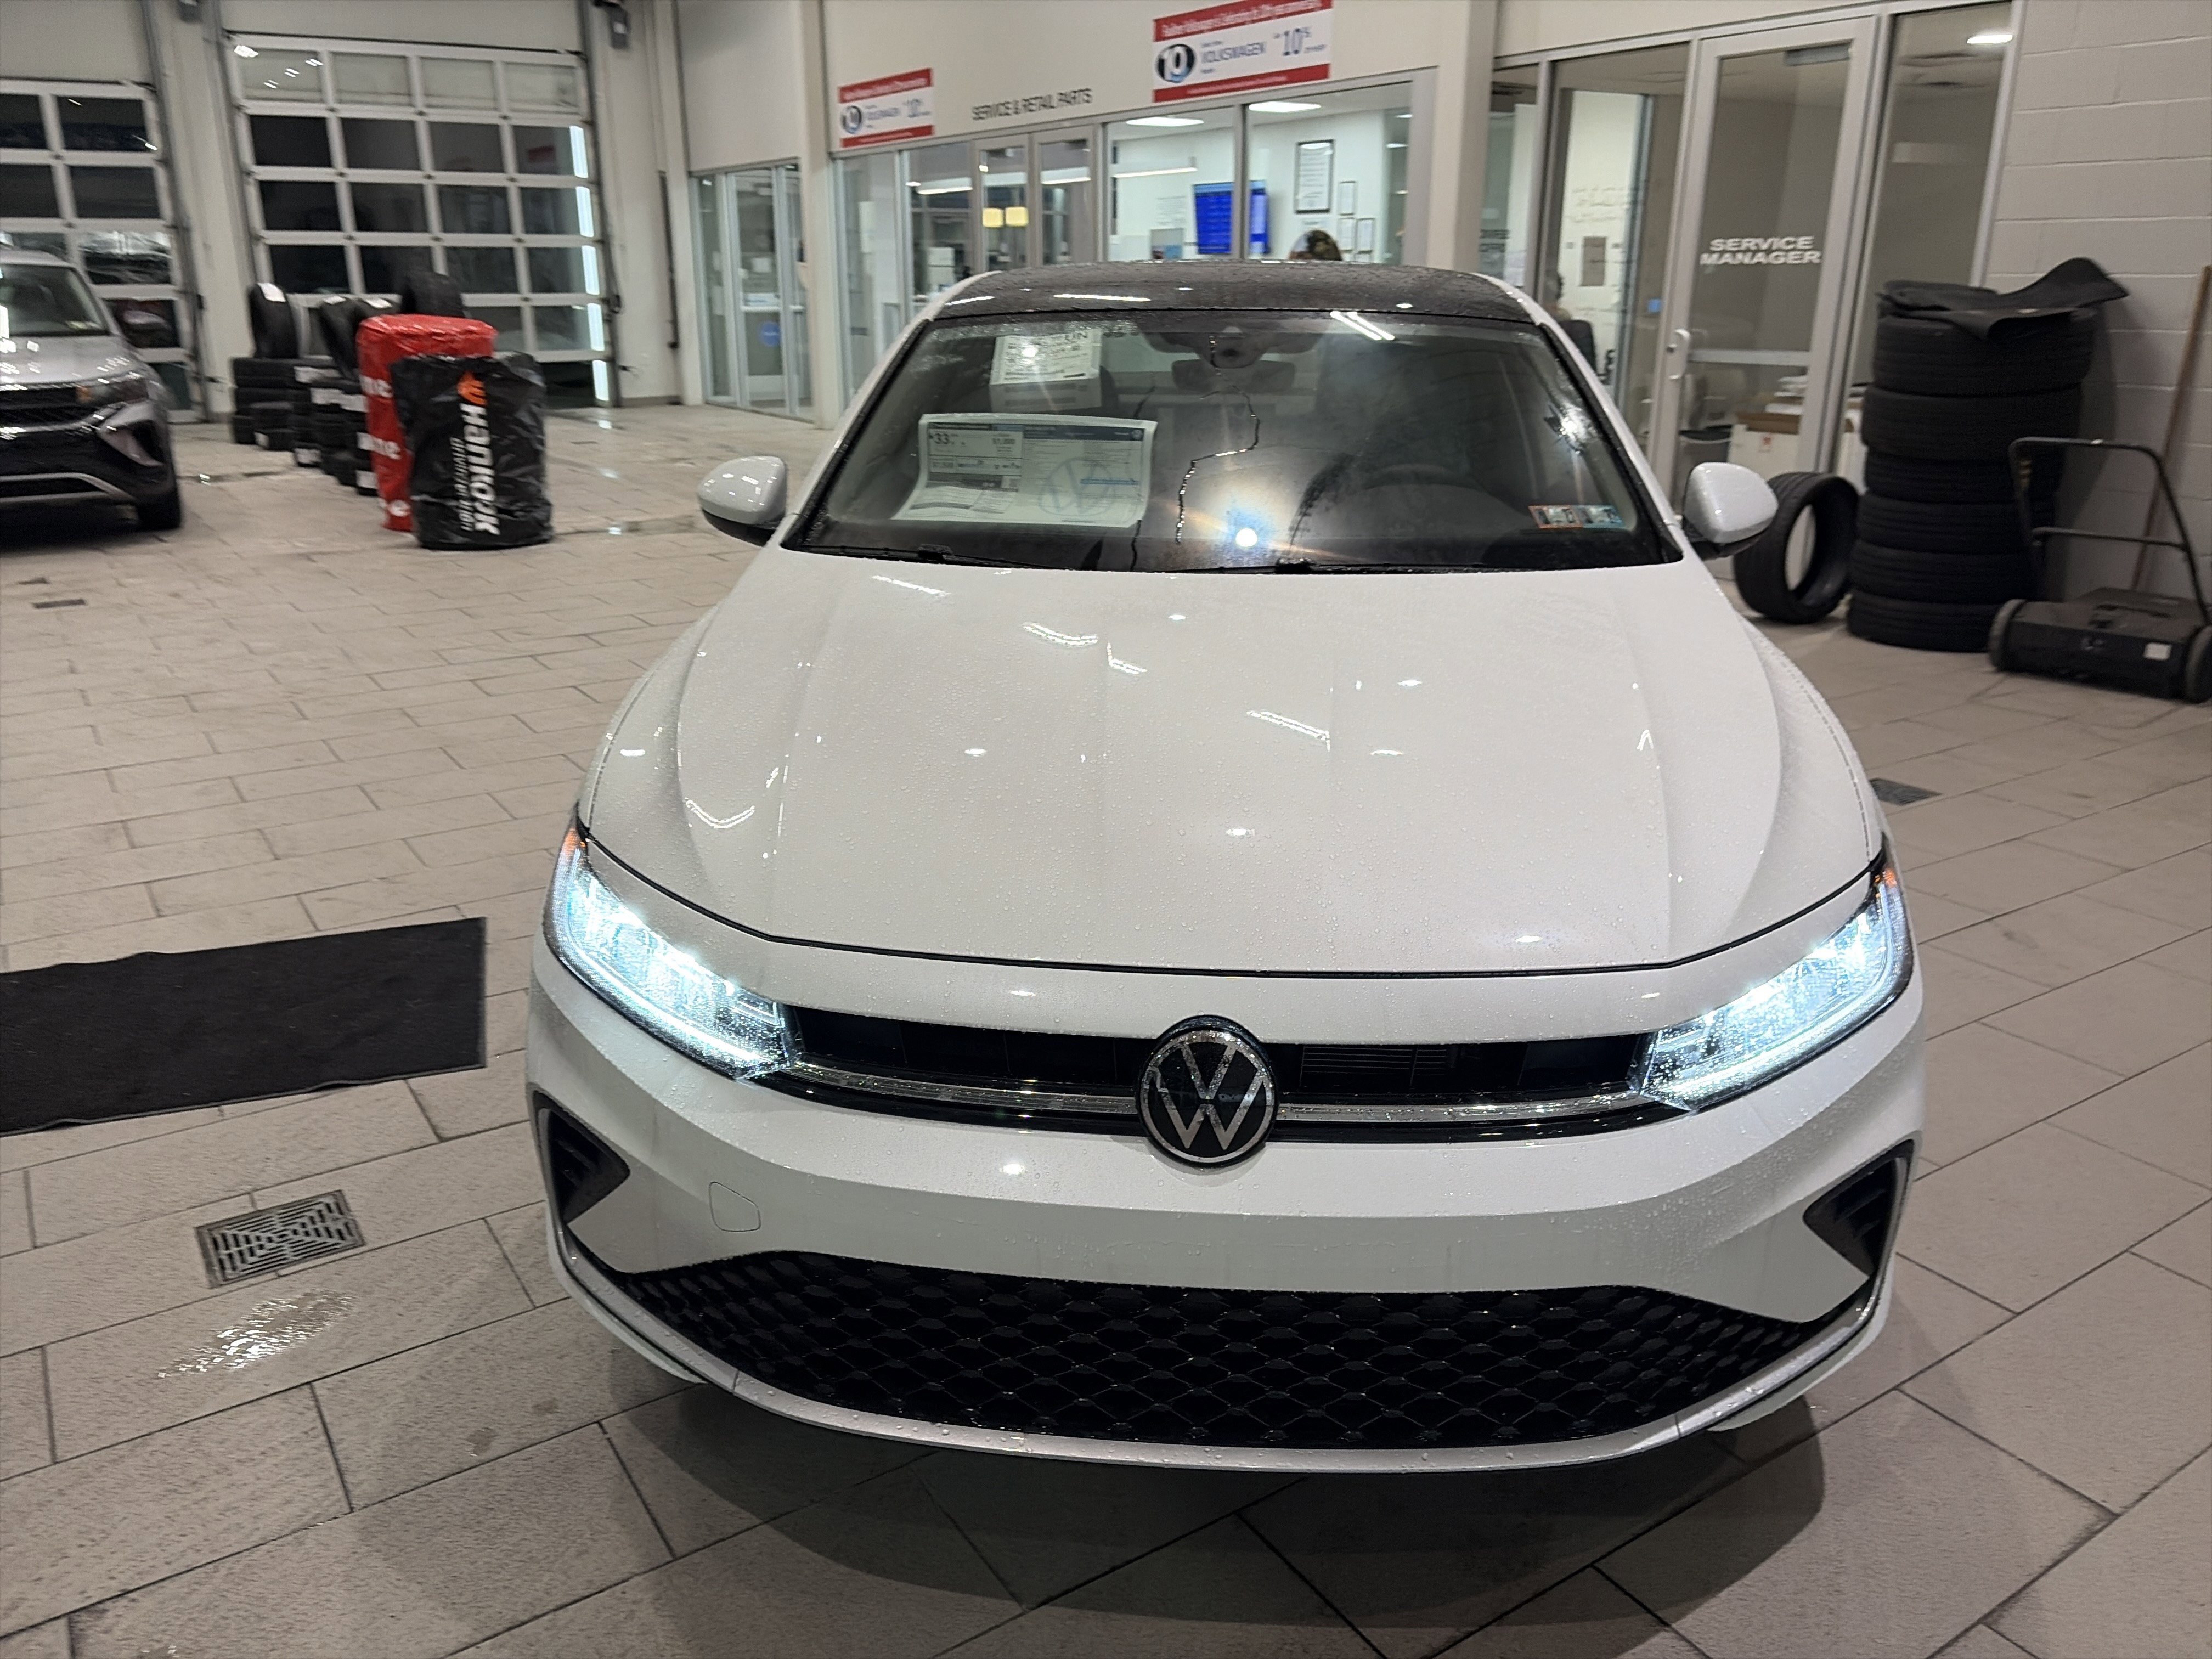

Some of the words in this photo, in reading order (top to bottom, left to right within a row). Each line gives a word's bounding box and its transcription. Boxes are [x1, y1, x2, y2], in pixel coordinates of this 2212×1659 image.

[972, 100, 1012, 121] SERVICE
[1022, 95, 1055, 114] RETAIL
[1057, 88, 1092, 109] PARTS
[1709, 236, 1814, 251] SERVICE
[1700, 250, 1822, 265] MANAGER
